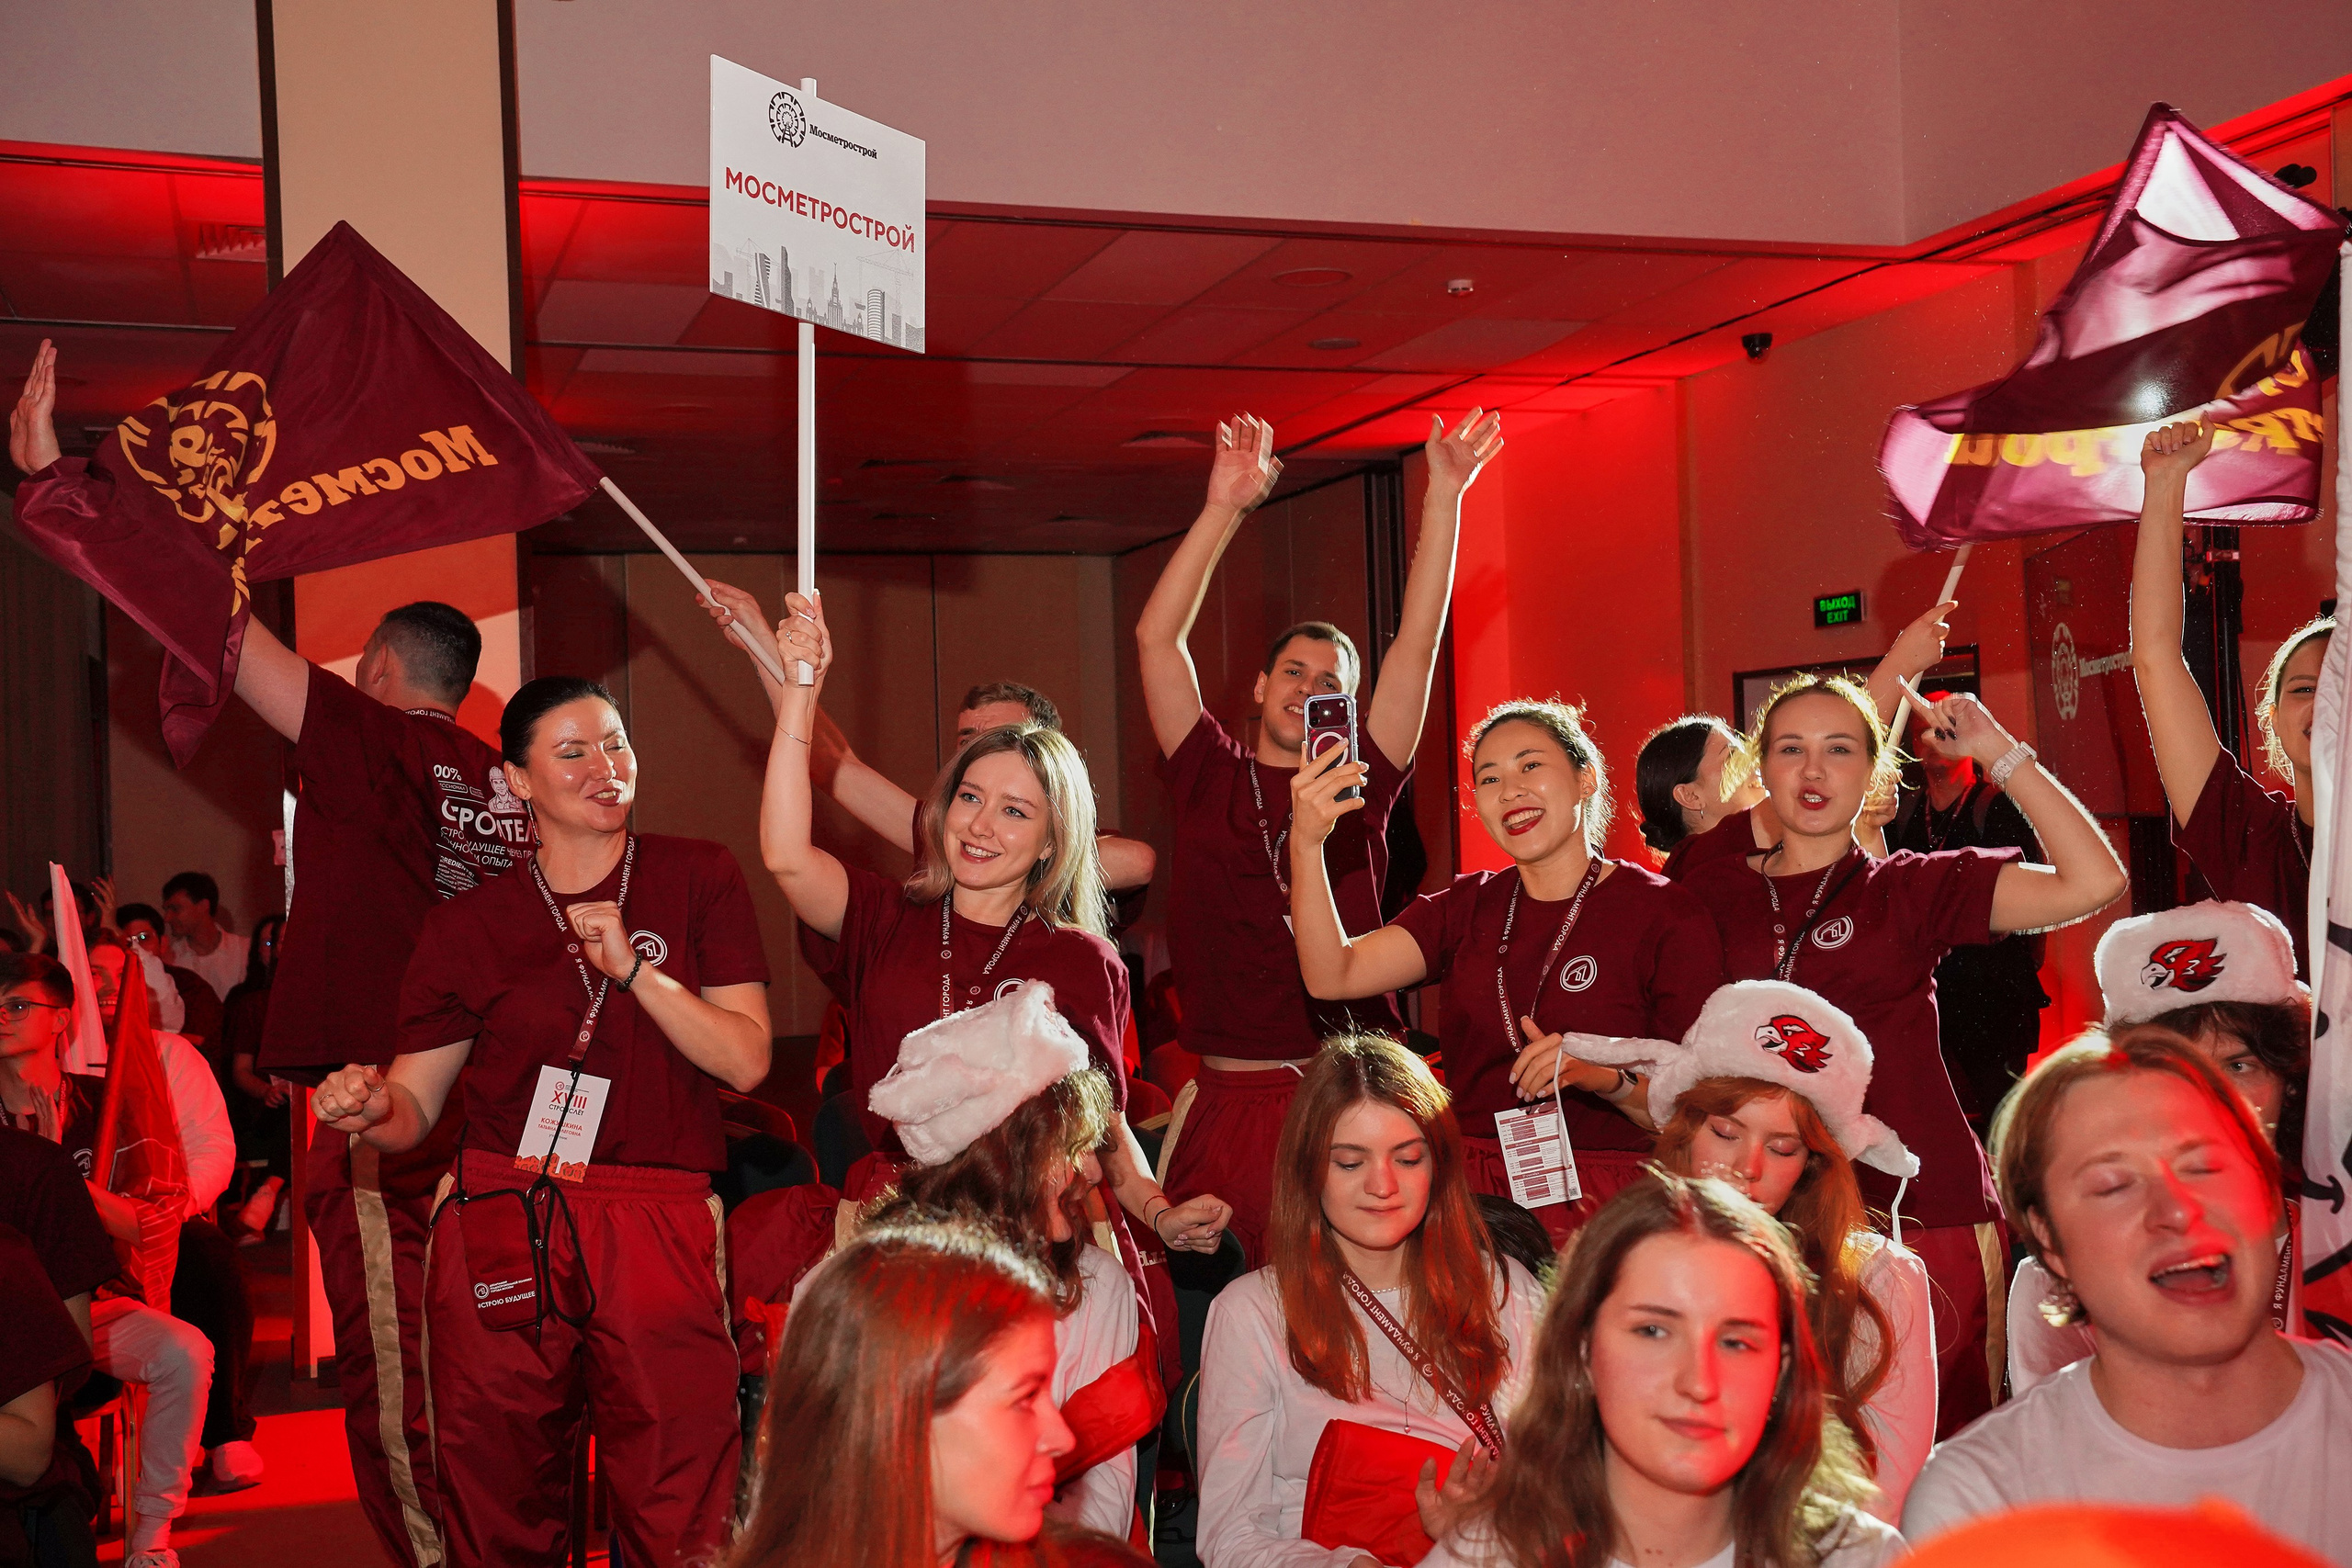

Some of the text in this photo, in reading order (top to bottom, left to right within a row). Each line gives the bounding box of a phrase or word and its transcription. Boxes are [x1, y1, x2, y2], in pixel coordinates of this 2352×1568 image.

[808, 123, 878, 160] Мосметрострой
[724, 166, 916, 254] МОСМЕТРОСТРОЙ
[1819, 595, 1856, 613] ВЫХОД
[1826, 610, 1849, 625] EXIT
[617, 836, 635, 908] ФУНДАМЕНТ ГОРОДА
[534, 868, 555, 907] ФУНДАМЕНТ
[549, 905, 568, 932] ГОРОДА
[1566, 881, 1591, 922] ФУНДАМЕНТ
[998, 918, 1022, 952] ФУНДАМЕНТ
[1553, 920, 1571, 951] ГОРОДА
[982, 950, 1002, 975] ГОРОДА
[943, 973, 951, 1007] ГОРОДА
[1497, 965, 1505, 998] ГОРОДА
[1500, 999, 1517, 1047] ФУНДАМЕНТ
[2274, 1245, 2292, 1302] ФУНДАМЕНТ
[504, 1291, 536, 1303] БУДУЩЕЕ
[1370, 1305, 1414, 1353] ФУНДАМЕНТ
